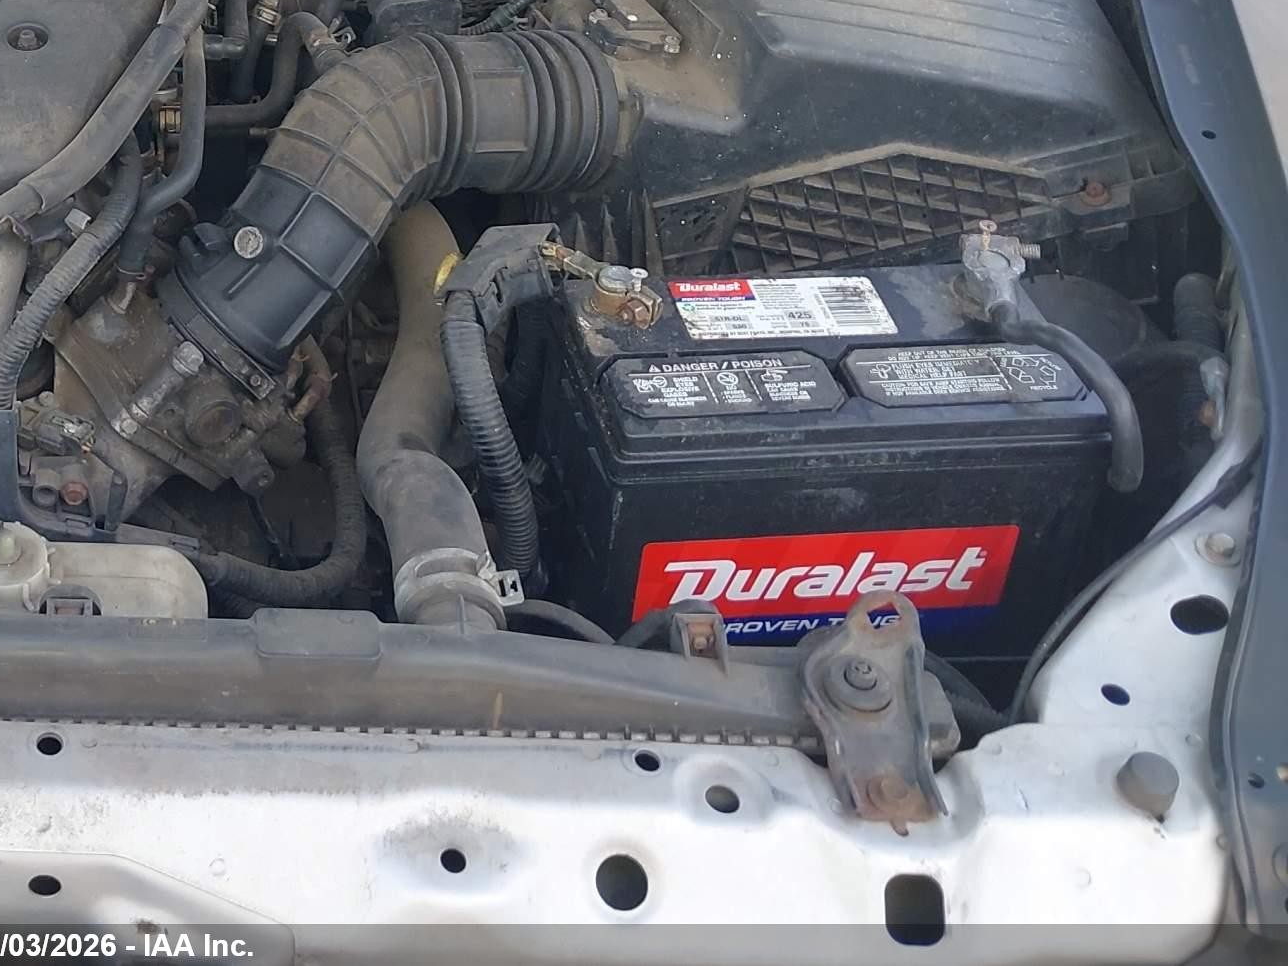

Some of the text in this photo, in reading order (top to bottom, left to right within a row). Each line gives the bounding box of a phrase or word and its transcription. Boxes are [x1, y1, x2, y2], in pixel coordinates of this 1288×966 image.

[675, 282, 741, 292] Duralast
[788, 311, 812, 319] 425
[662, 362, 719, 373] DANGER
[733, 359, 783, 369] POISON
[664, 547, 987, 604] Duralast
[723, 619, 818, 634] ROVEN
